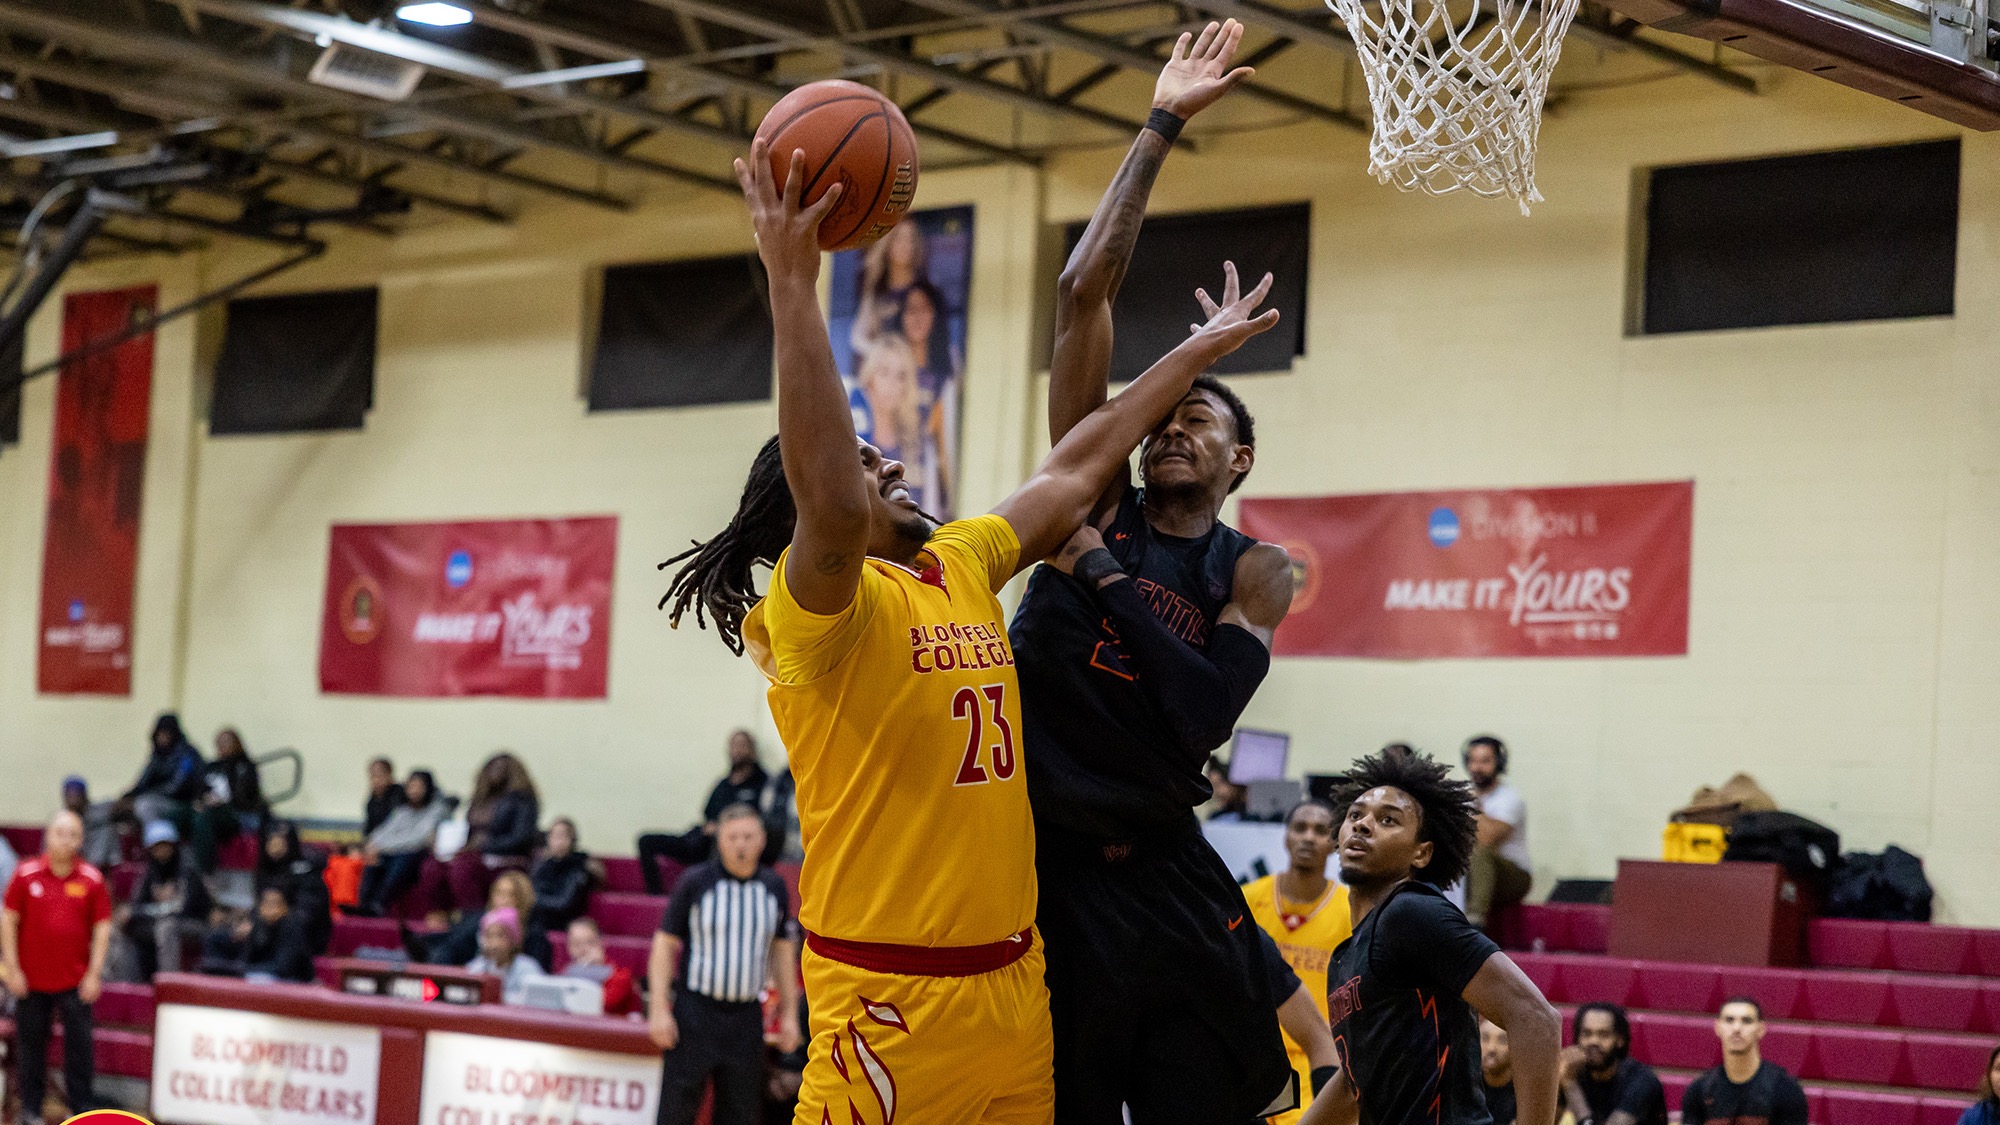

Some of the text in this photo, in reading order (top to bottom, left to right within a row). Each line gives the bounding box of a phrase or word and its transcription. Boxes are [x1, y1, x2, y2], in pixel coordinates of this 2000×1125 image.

[883, 160, 912, 213] THE
[1384, 553, 1631, 626] MAKE IT YOURS
[951, 682, 1016, 787] 23
[191, 1034, 347, 1076] BLOOMFIELD
[169, 1071, 365, 1120] COLLEGE BEARS
[465, 1064, 645, 1111] BLOOMFIELD
